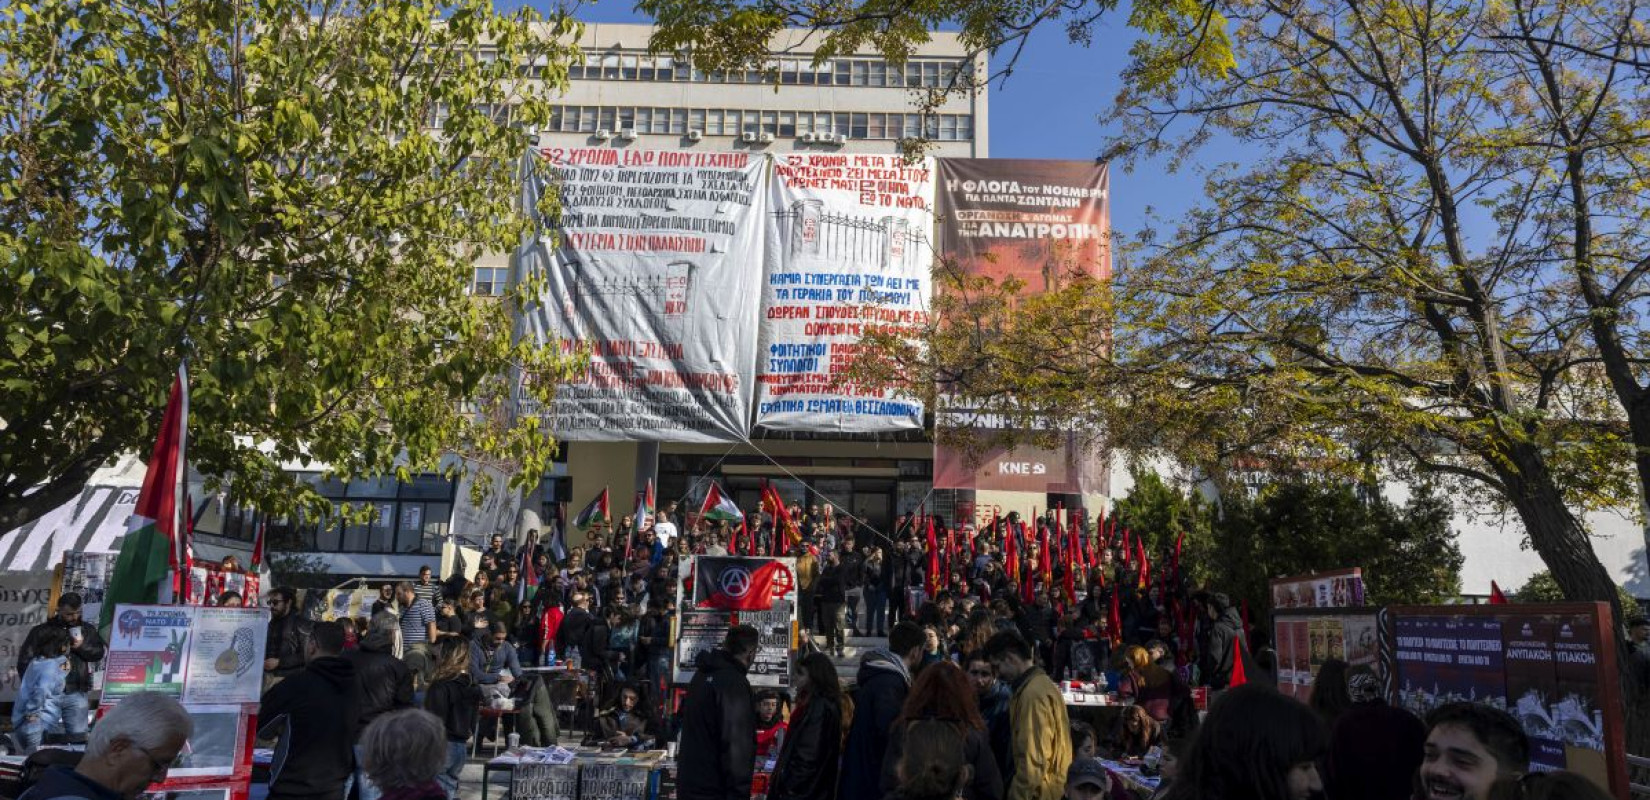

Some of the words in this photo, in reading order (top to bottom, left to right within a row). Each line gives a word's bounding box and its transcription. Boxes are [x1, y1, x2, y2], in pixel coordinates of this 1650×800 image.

[541, 149, 564, 165] 52
[569, 149, 618, 165] ΧΡΟΝΙΑ
[788, 156, 802, 166] 52
[809, 156, 848, 167] ΧΡΟΝΙΑ
[854, 156, 885, 167] ΜΕΤΑ
[867, 168, 897, 180] ΜΕΣΑ
[786, 178, 829, 189] ΑΓΩΝΕΣ
[947, 179, 958, 192] Η
[962, 180, 1021, 193] ΦΛΟΓΑ
[1023, 186, 1040, 194] ΤΟΥ
[1043, 185, 1107, 198] ΝΟΕΜΒΡΗ
[879, 193, 892, 207] ΤΟ
[896, 195, 926, 210] ΝΑΤΟ
[966, 194, 981, 202] ΓΙΑ
[983, 194, 1016, 203] ΠΑΝΤΑ
[1017, 195, 1081, 208] ΖΩΝΤΑΝΗ
[958, 211, 1022, 220] ΟΡΓΑΝΩΣΗ
[958, 229, 978, 238] ΤΗΝ
[978, 223, 1099, 239] ΑΝΑΤΡΟΠΗ
[770, 273, 802, 285] ΚΑΜΙΑ
[804, 273, 861, 286] ΣΥΝΕΡΓΑΣΙΑ
[863, 274, 884, 287] ΤΩΝ
[886, 277, 902, 289] ΑΕΙ
[906, 278, 920, 290] ΜΕ
[776, 288, 789, 300] ΤΑ
[792, 288, 833, 300] ΓΕΡΑΚΙΑ
[836, 289, 854, 301] ΤΟΥ
[767, 306, 810, 319] ΔΩΡΕΑΝ
[770, 343, 827, 357] ΦΟΙΤΗΤΙΚΟΙ
[770, 358, 818, 373] ΣΥΛΛΟΓΟΙ
[761, 400, 804, 414] ΕΡΓΑΤΙΚΑ
[807, 400, 854, 413] ΣΩΜΑΤΕΙΑ
[856, 401, 920, 417] ΘΕΣΣΑΛΟΝΙΚΗΣ
[1507, 648, 1552, 660] ΑΝΥΠΑΚΟΗ
[1555, 651, 1596, 664] ΥΠΑΚΟΗ
